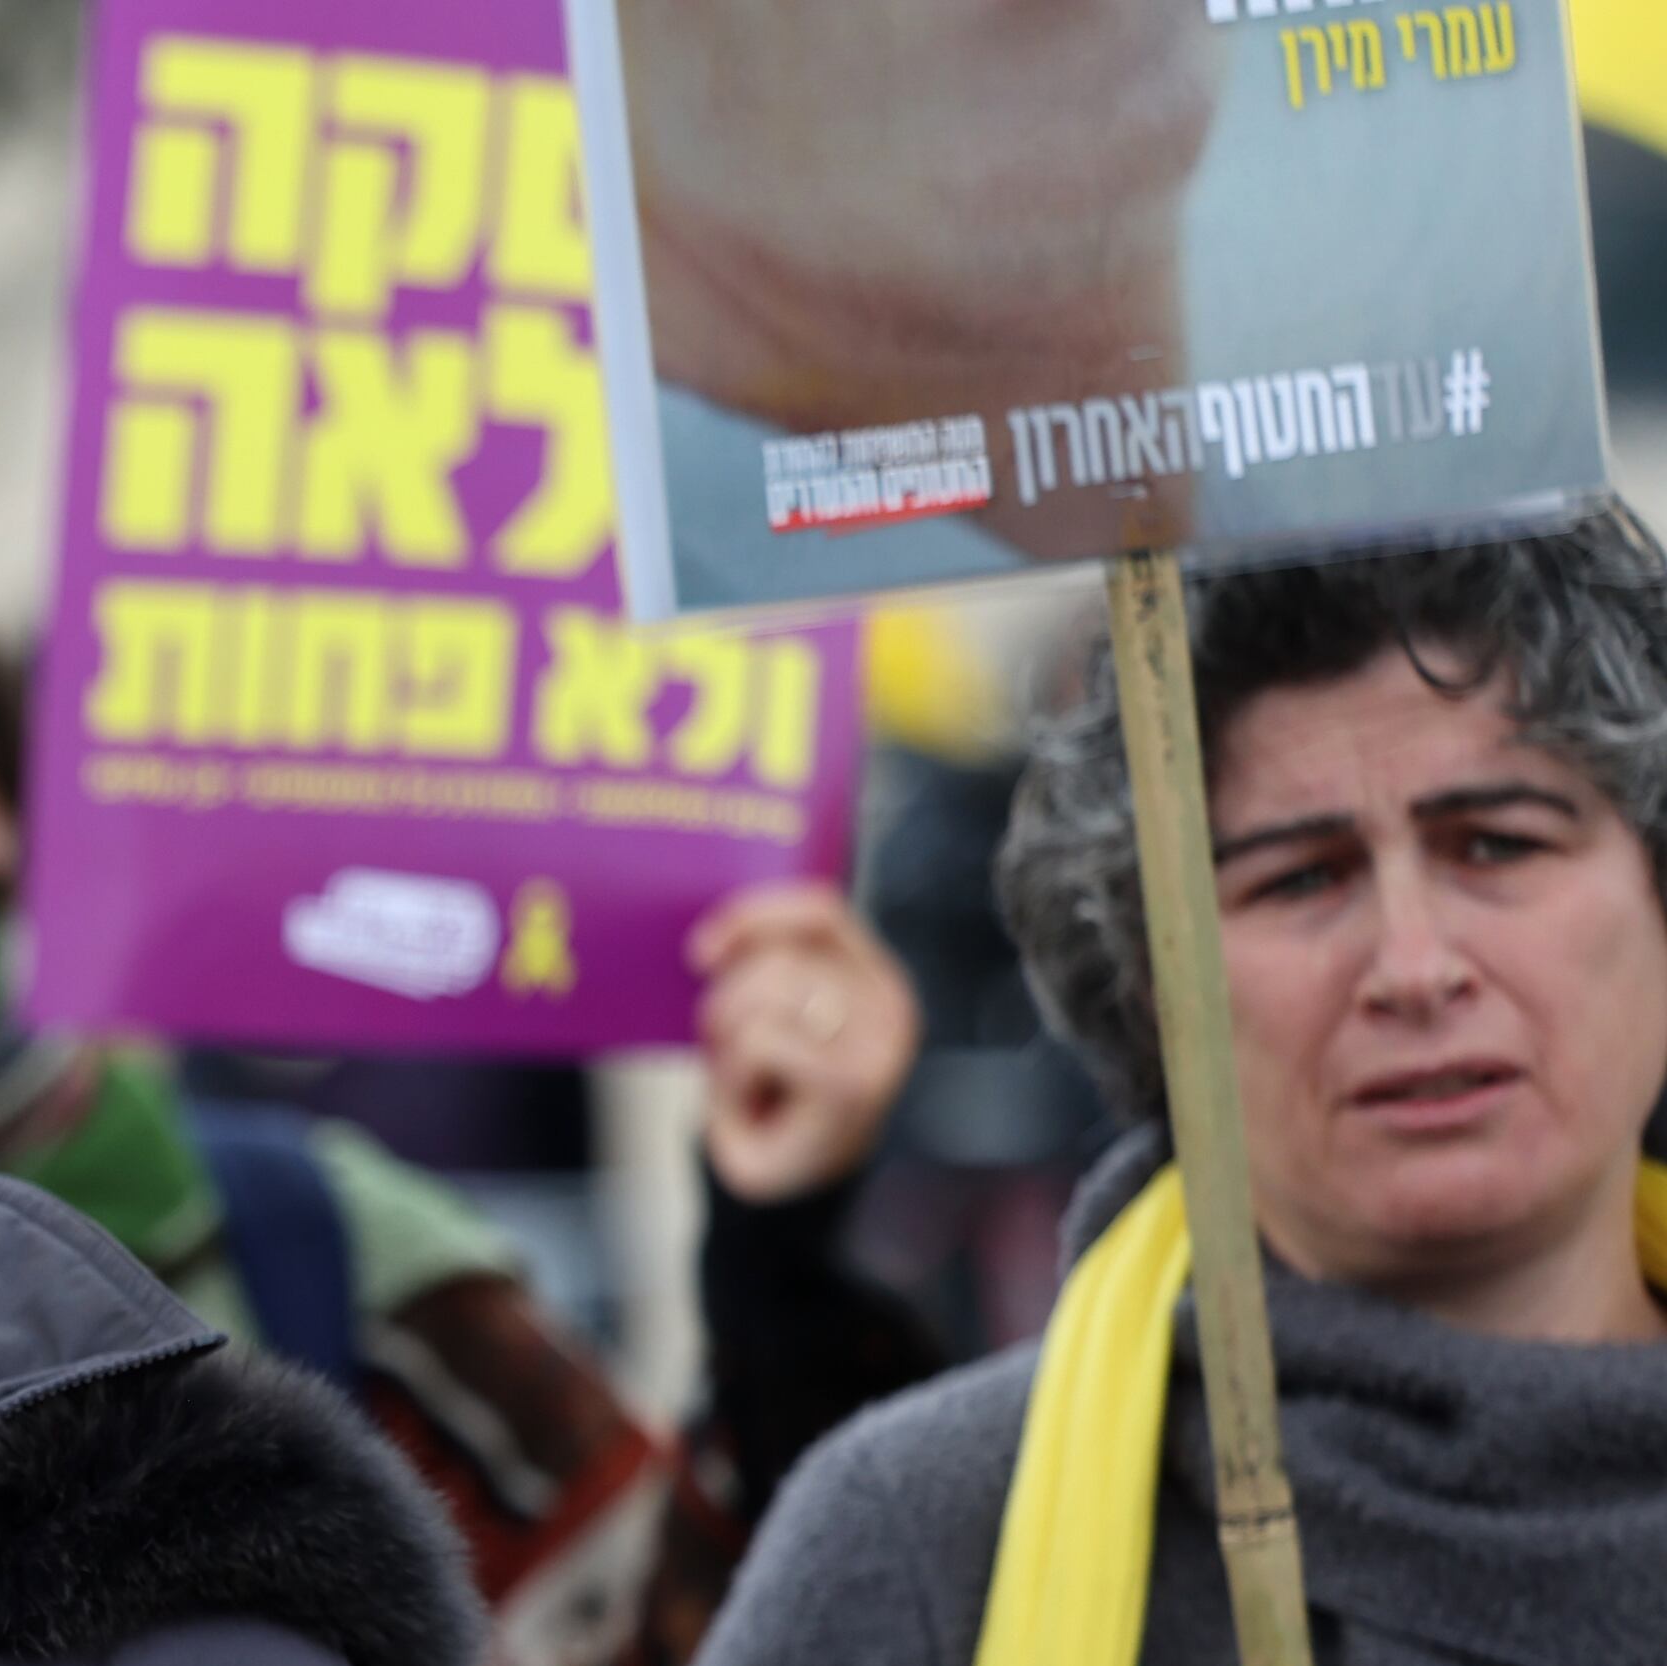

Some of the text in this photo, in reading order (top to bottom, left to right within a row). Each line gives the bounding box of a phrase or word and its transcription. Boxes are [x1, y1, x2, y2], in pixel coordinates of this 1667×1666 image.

[1280, 2, 1515, 110] עמרי מירן
[85, 580, 820, 792] ולא פחות
